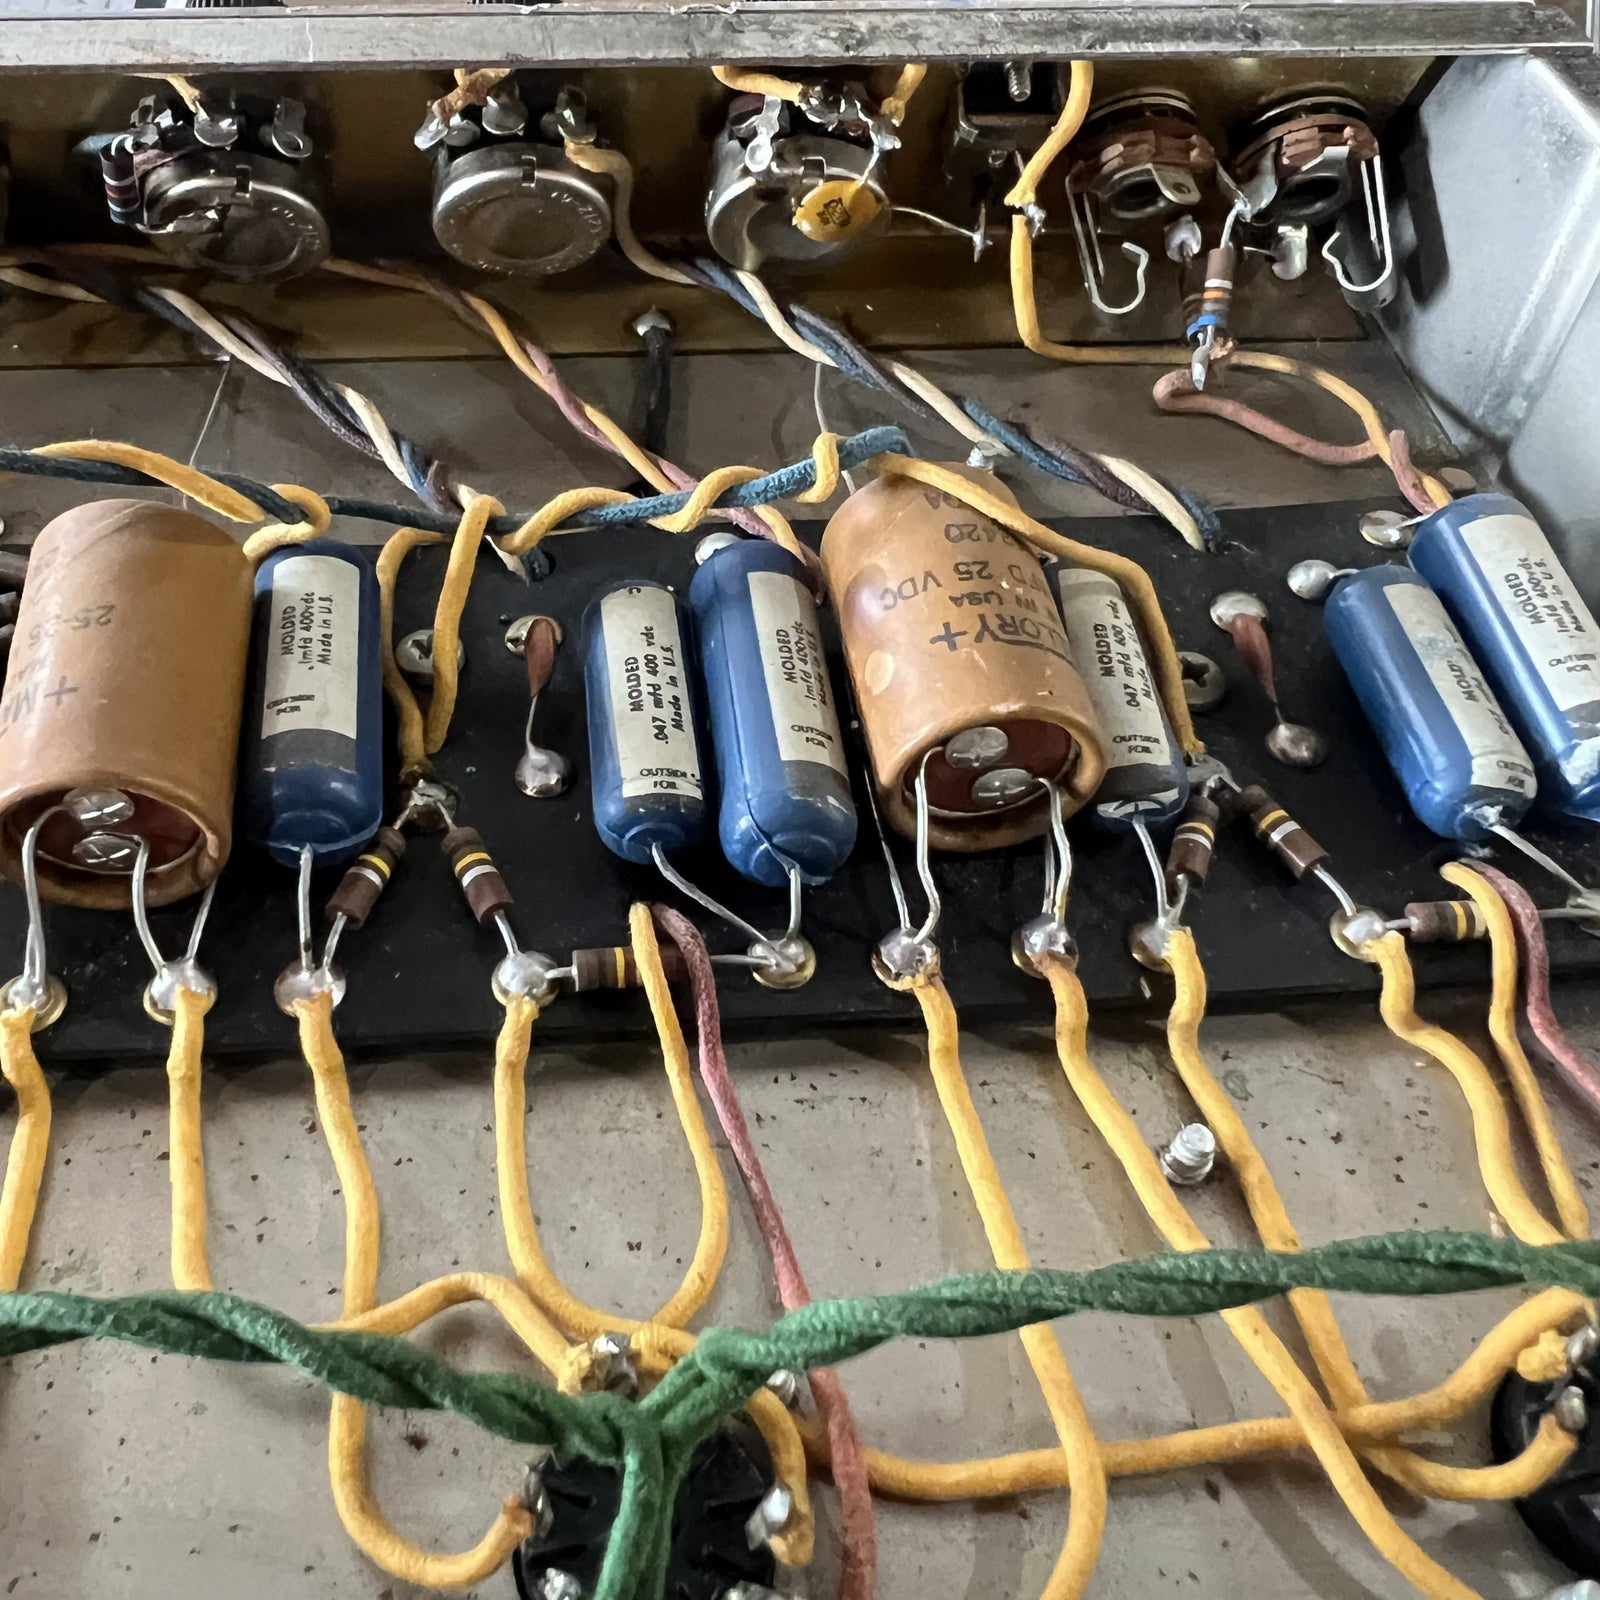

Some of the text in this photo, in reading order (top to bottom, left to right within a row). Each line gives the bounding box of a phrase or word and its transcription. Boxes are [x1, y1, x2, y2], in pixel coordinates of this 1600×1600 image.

[953, 561, 994, 581] 25
[879, 571, 943, 610] VDC
[1503, 573, 1546, 625] MOLDED
[640, 626, 655, 646] vdc
[1093, 623, 1116, 677] MOLDED
[644, 654, 659, 676] 400
[776, 629, 798, 683] MOLDED
[624, 657, 644, 712] MOLDED
[666, 675, 678, 688] in
[668, 695, 685, 732] Made
